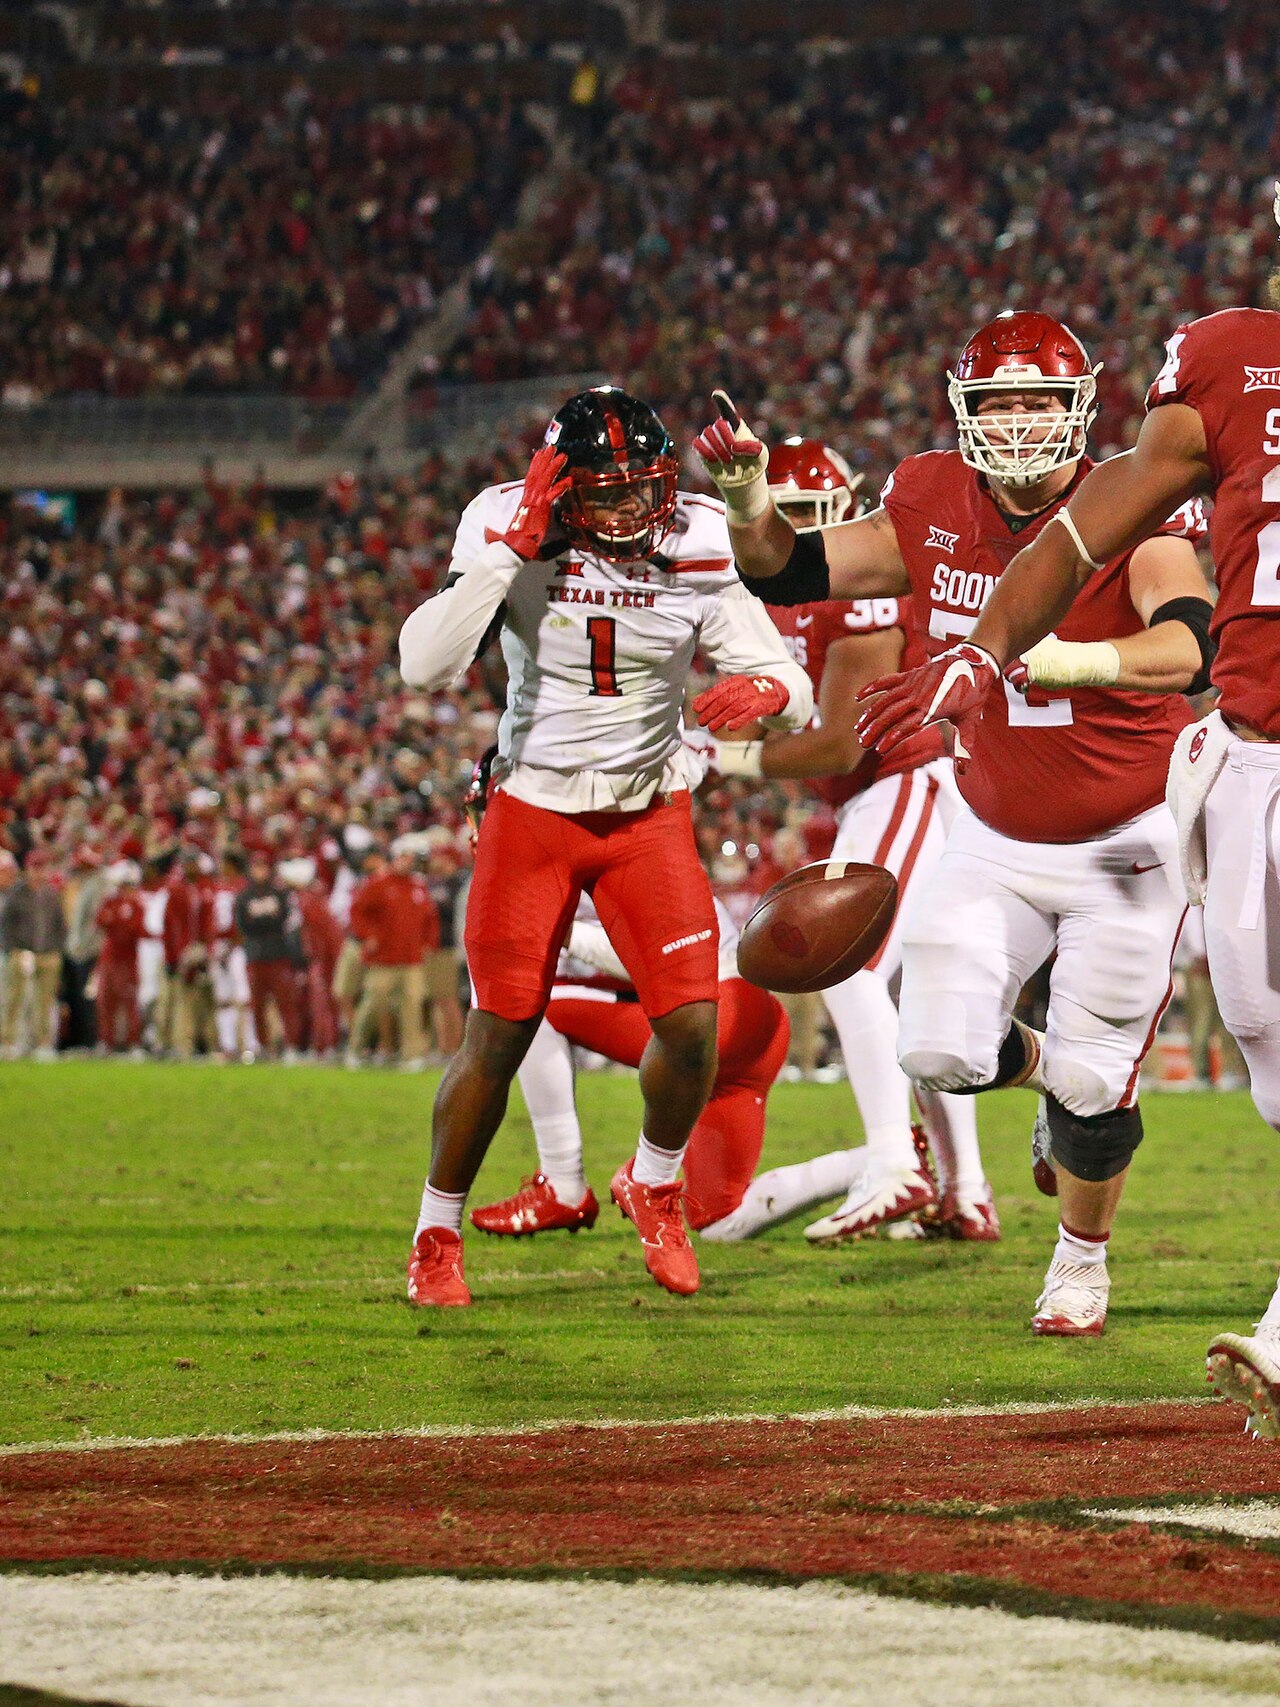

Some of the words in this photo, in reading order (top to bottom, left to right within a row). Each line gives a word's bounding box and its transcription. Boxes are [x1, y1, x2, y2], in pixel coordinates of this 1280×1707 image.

[546, 585, 605, 605] TEXAS
[610, 591, 656, 607] TECH
[930, 562, 1000, 609] SOON
[586, 617, 623, 696] 1
[662, 934, 699, 954] GUNS
